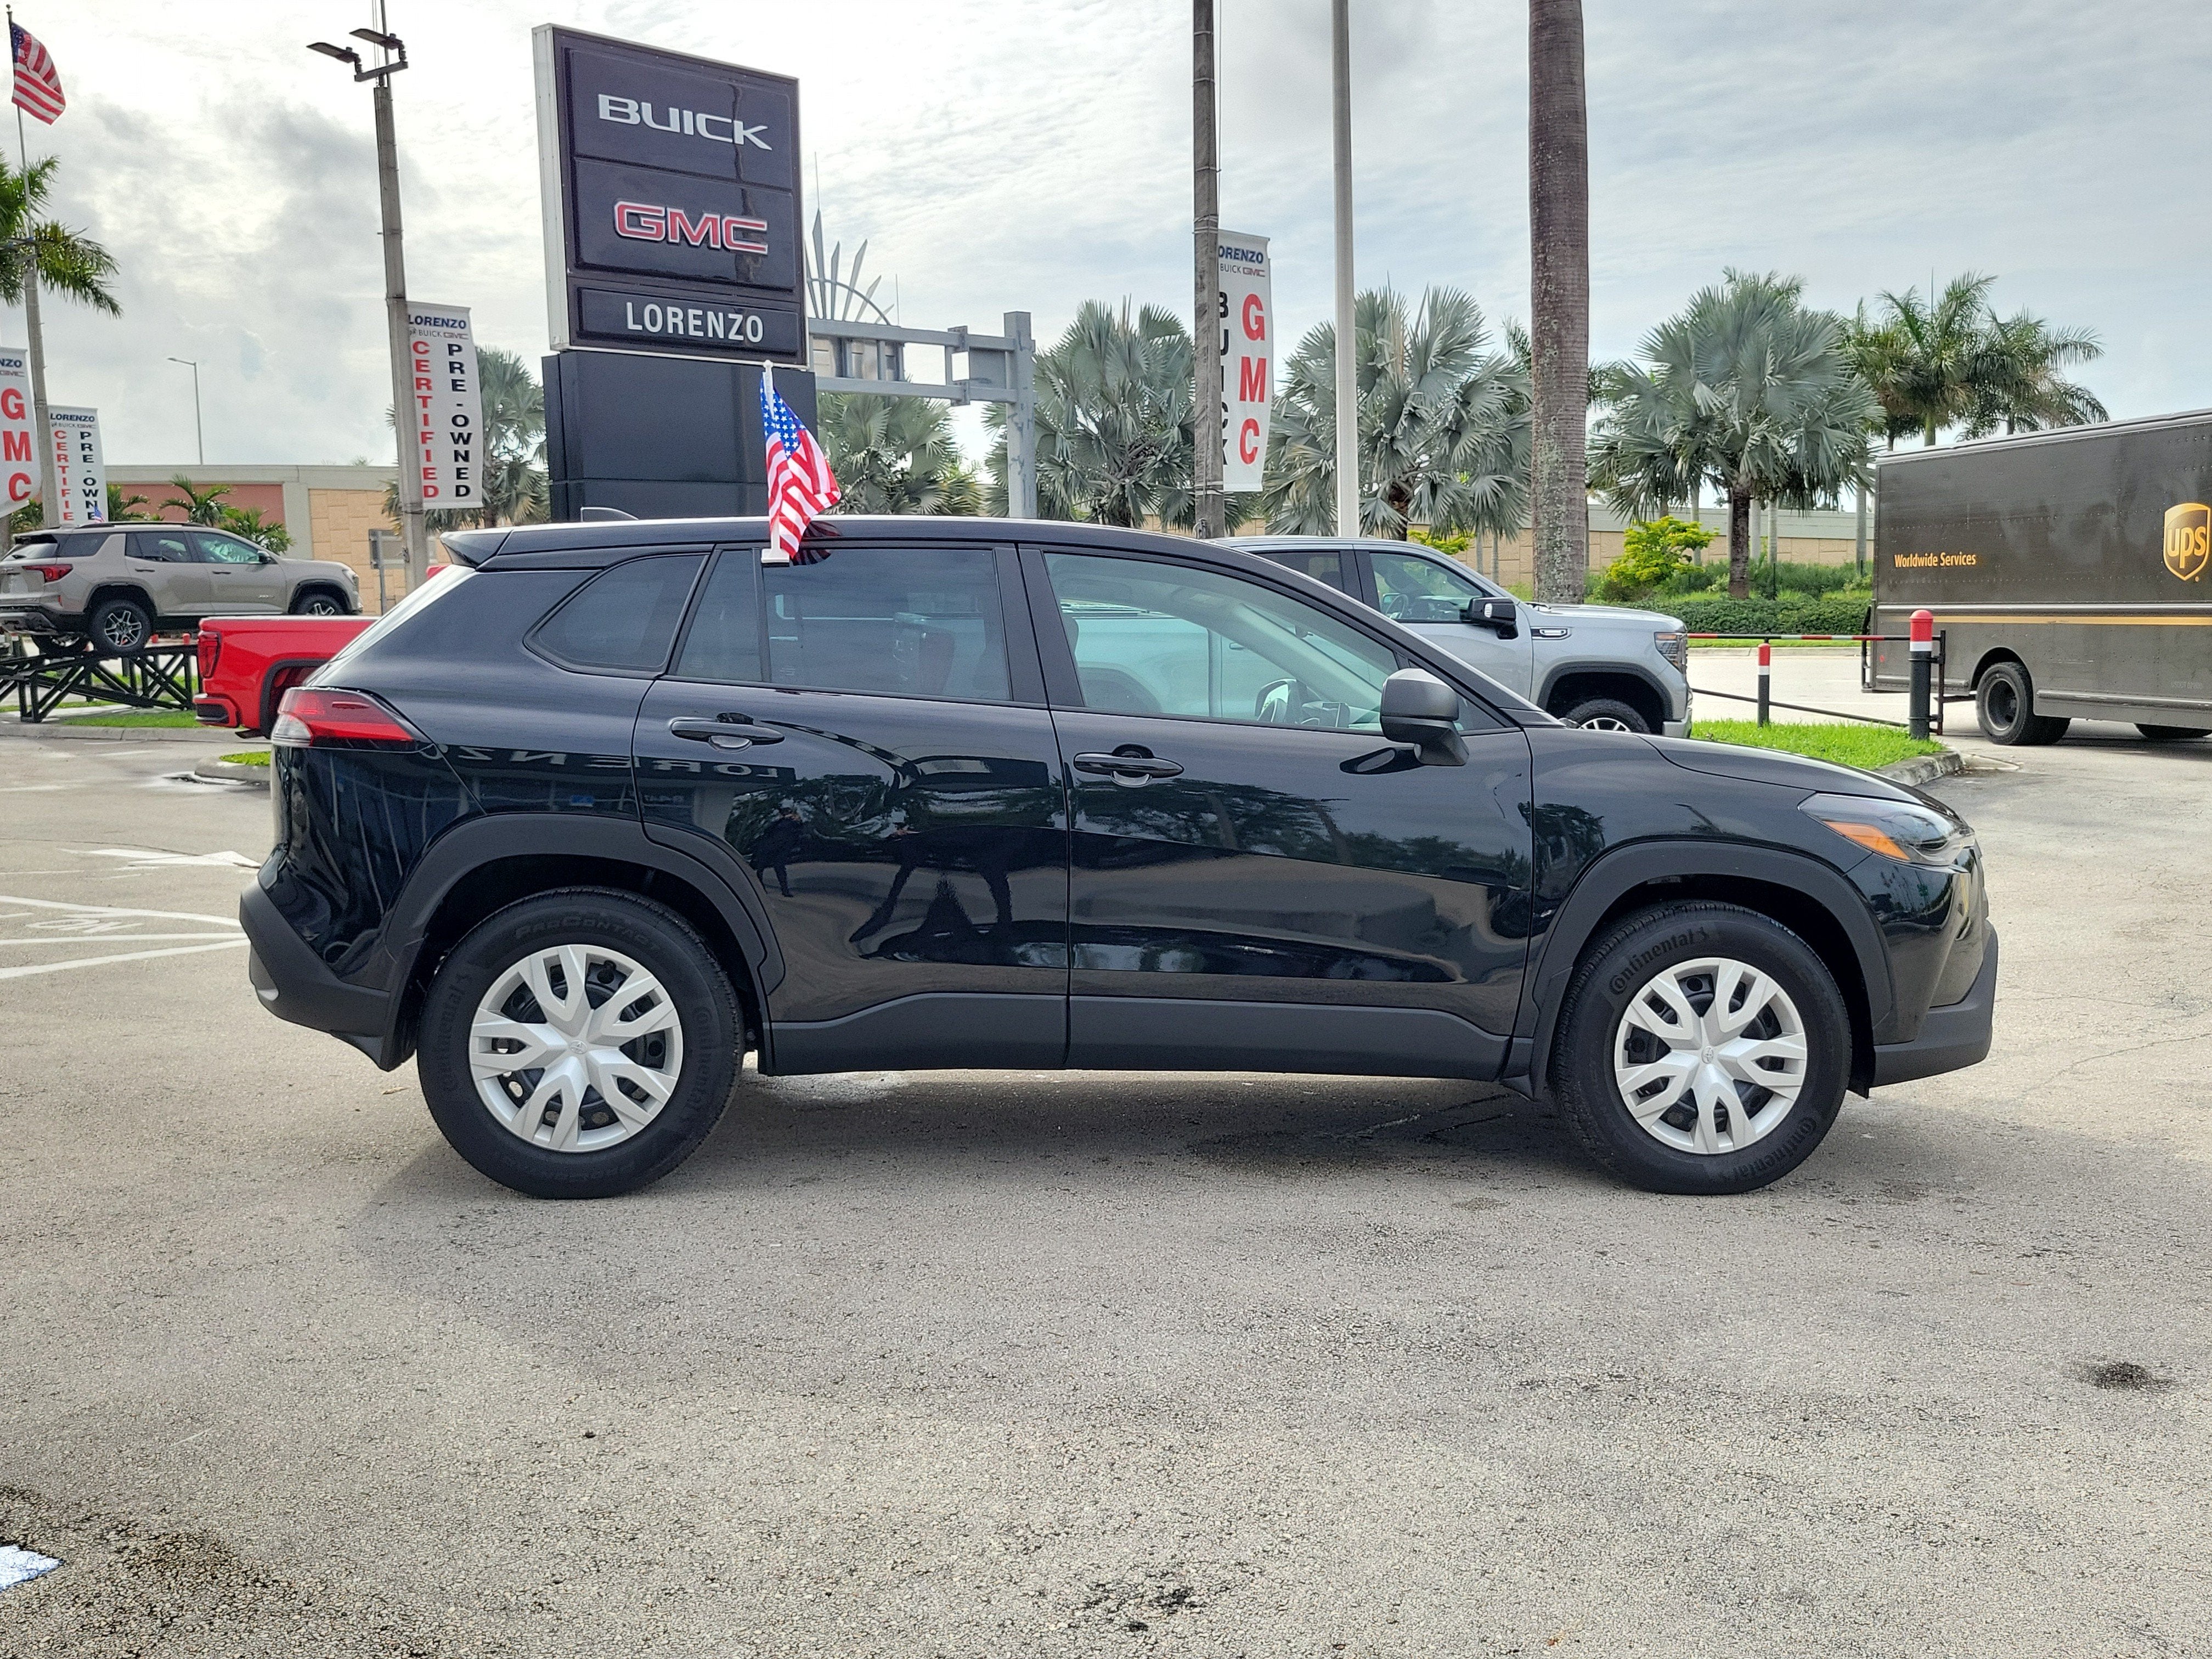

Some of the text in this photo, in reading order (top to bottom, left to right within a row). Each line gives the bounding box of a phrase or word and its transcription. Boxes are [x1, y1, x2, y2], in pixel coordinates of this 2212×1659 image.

[597, 93, 772, 151] BUICK
[614, 200, 769, 255] GMC
[1220, 263, 1266, 277] BUICK GMC
[408, 314, 466, 329] LORENZO
[419, 329, 442, 337] BUICK
[626, 301, 764, 343] LORENZO
[1239, 293, 1267, 465] GMC
[50, 413, 95, 422] LORENZO
[413, 341, 439, 498] CERTIFIED
[447, 343, 473, 498] PRE-OWNED
[1, 387, 32, 502] GMC
[1894, 551, 1976, 568] Worldwide Services
[2166, 526, 2207, 568] ups
